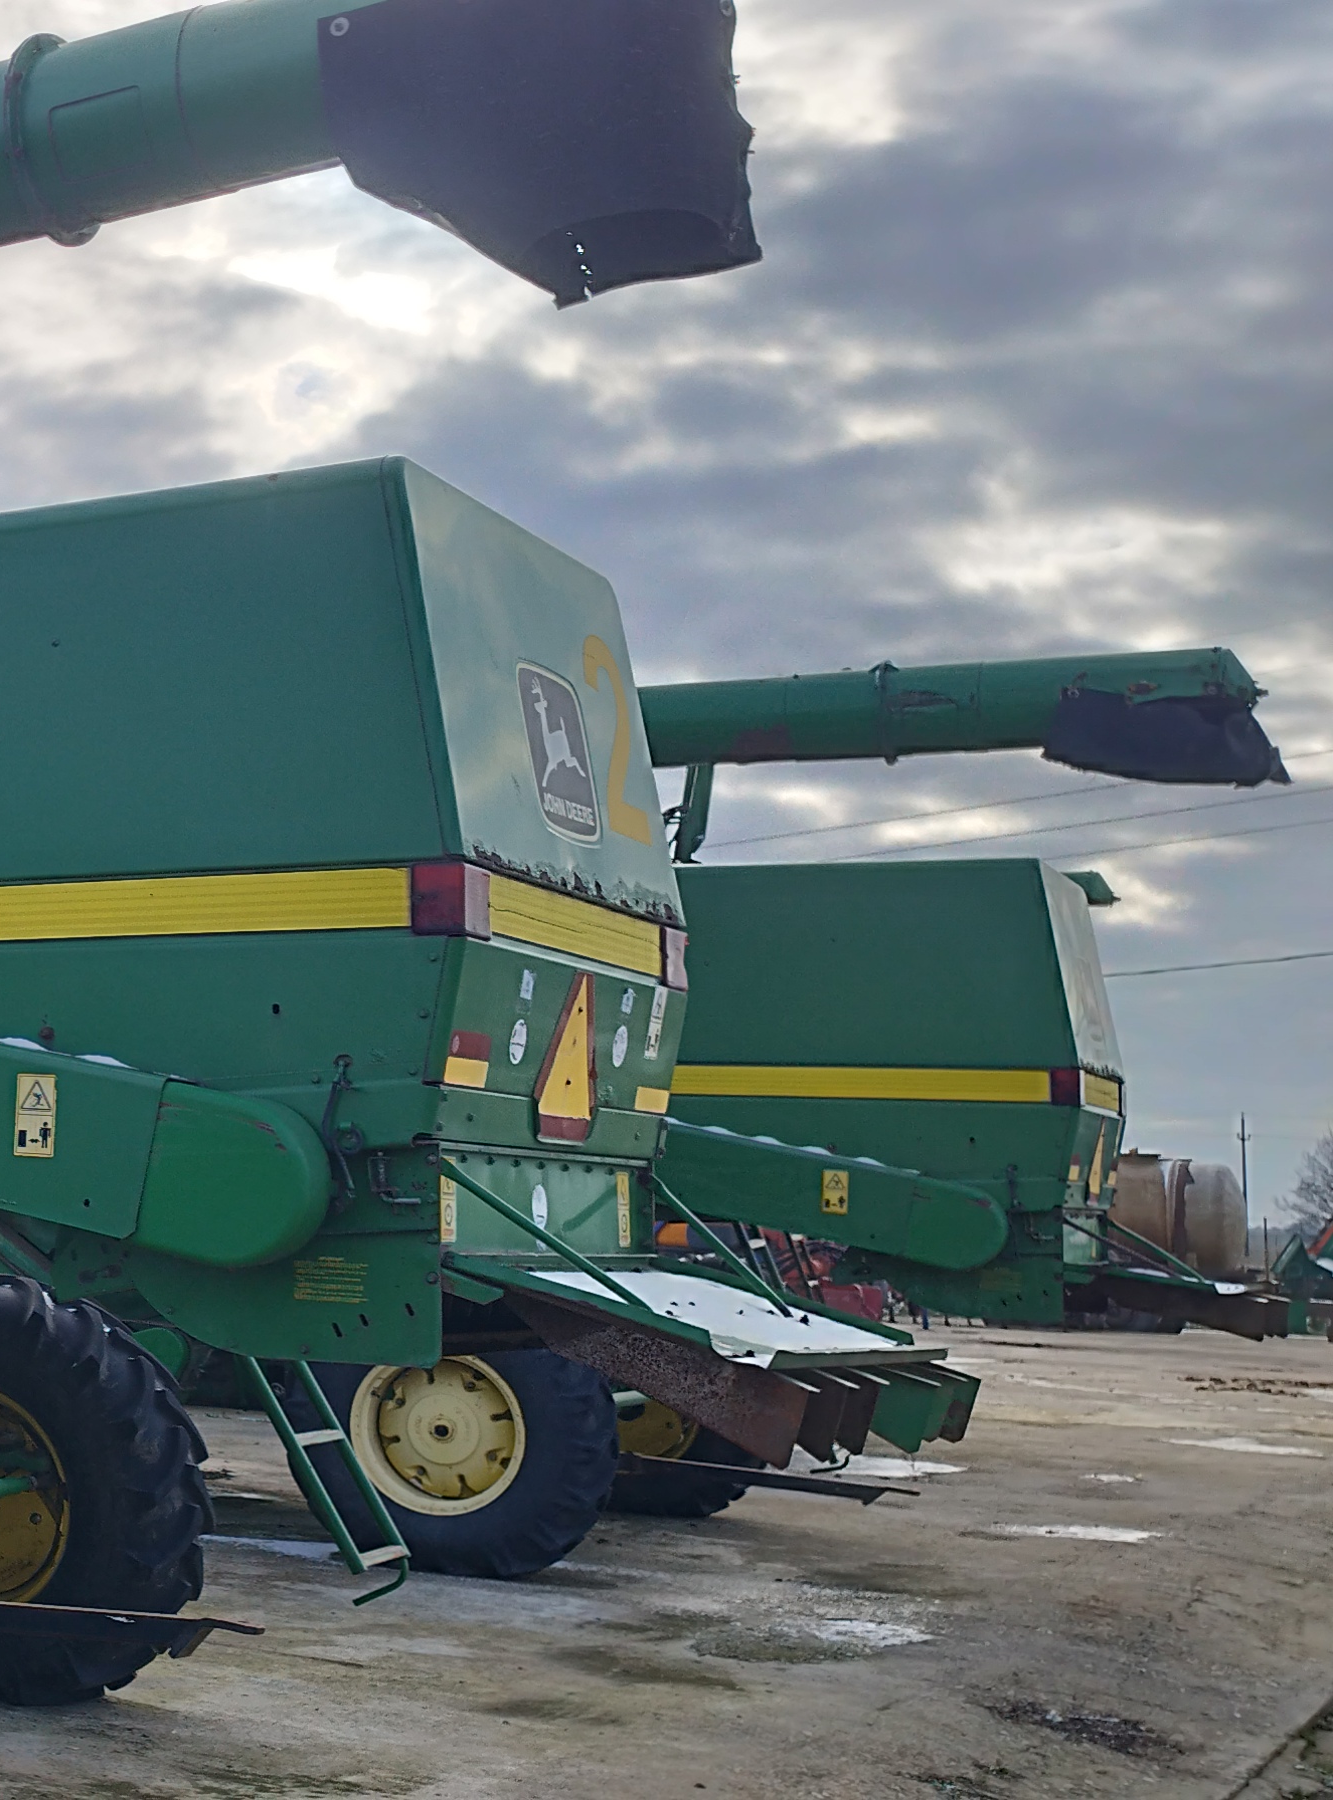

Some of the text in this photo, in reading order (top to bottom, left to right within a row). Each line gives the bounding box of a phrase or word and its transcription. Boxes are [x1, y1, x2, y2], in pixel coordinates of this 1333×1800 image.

[583, 635, 652, 846] 2
[542, 792, 595, 826] JOHN DEERE
